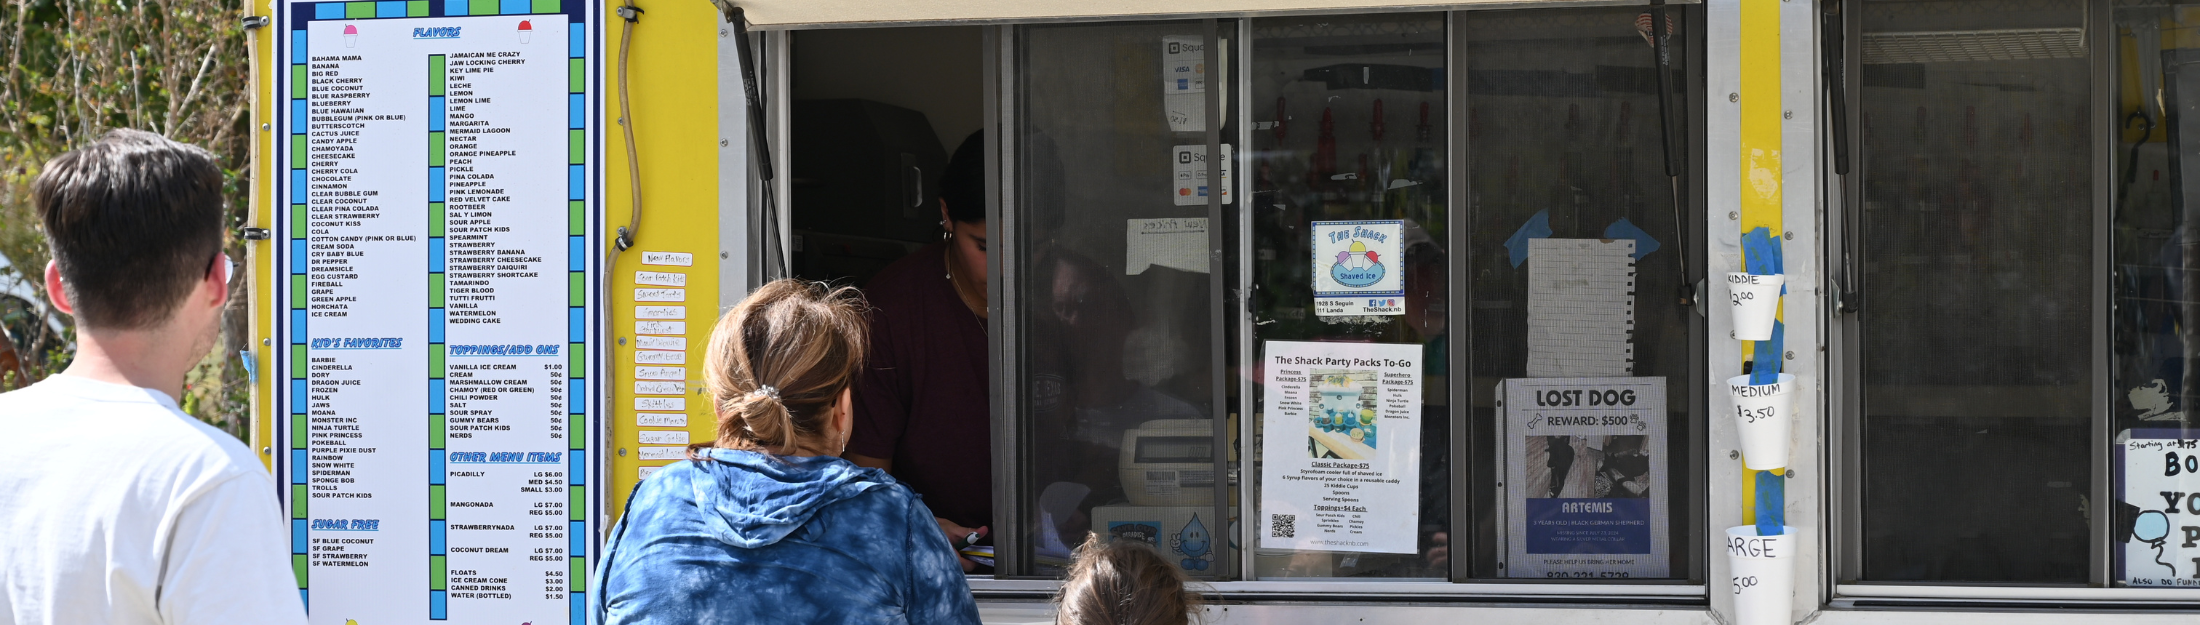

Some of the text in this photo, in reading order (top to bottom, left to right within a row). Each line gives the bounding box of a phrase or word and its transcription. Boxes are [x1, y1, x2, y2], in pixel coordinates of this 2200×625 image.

[413, 26, 461, 38] FLAVORS
[312, 54, 340, 62] BAHAMA
[498, 50, 520, 58] CRAZY
[355, 114, 373, 122] (PINK
[386, 114, 406, 122] BLUE)
[1340, 272, 1376, 280] Shaved Ice
[1728, 274, 1760, 284] KIDDIE
[311, 338, 402, 349] KID'S FAVORITES
[449, 345, 559, 355] TOPPINGS/ADD ONS
[1275, 356, 1411, 368] The Shack Party Packs To-Go
[1731, 383, 1780, 398] MEDIUM
[1537, 389, 1636, 407] LOST DOG
[1737, 404, 1775, 423] $3.50
[1547, 415, 1628, 427] REWARD: $500
[2129, 440, 2163, 451] Starting
[450, 452, 562, 463] OTHER MENU ITEMS
[1562, 502, 1613, 513] ARTEMIS
[311, 519, 379, 530] SUGAR FREE
[1726, 535, 1777, 558] ARGE
[2132, 577, 2153, 585] ALSO
[2161, 577, 2172, 585] DO
[476, 592, 511, 600] (BOTTLED)
